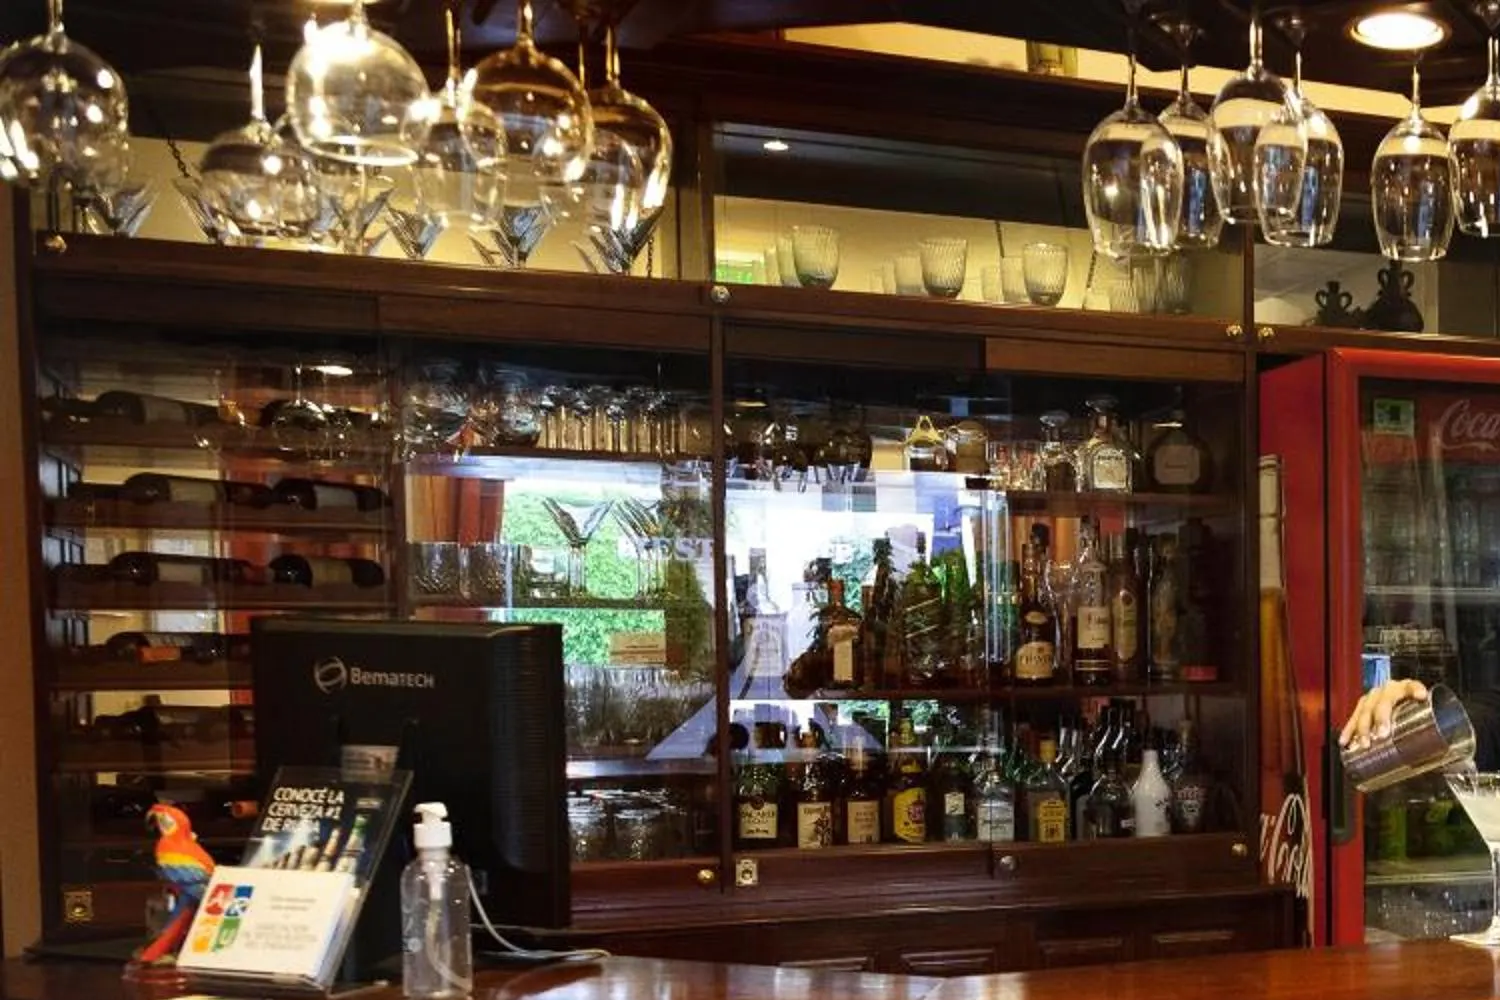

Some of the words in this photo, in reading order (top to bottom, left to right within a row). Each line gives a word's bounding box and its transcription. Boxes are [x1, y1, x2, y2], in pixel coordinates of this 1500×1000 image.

[327, 790, 345, 804] LA
[267, 802, 324, 819] CERVEZA
[261, 816, 283, 833] DE
